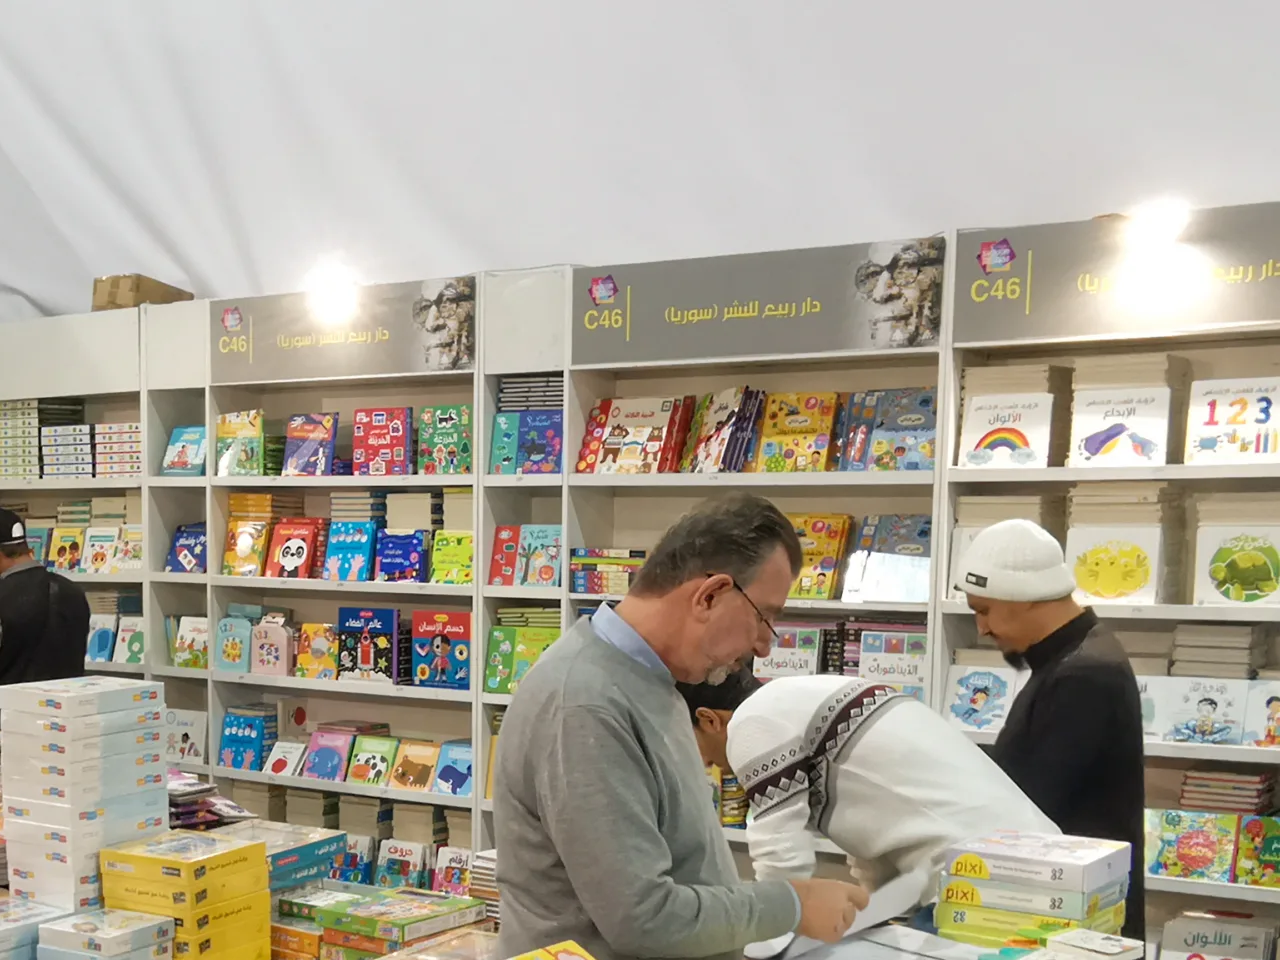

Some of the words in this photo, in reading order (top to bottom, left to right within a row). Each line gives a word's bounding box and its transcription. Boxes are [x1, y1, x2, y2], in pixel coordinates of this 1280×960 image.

[970, 276, 1022, 303] C46
[665, 303, 718, 325] (سوريا)
[722, 301, 760, 321] للنشر
[762, 300, 798, 319] ربيع
[800, 297, 822, 315] دار
[584, 309, 624, 331] C46
[219, 334, 248, 354] C46
[1203, 400, 1219, 426] 1
[1226, 397, 1248, 425] 2
[1255, 396, 1273, 424] 3
[443, 624, 465, 634] جسم
[387, 844, 414, 858] حروف
[955, 859, 983, 876] pixi
[945, 886, 975, 903] pixi
